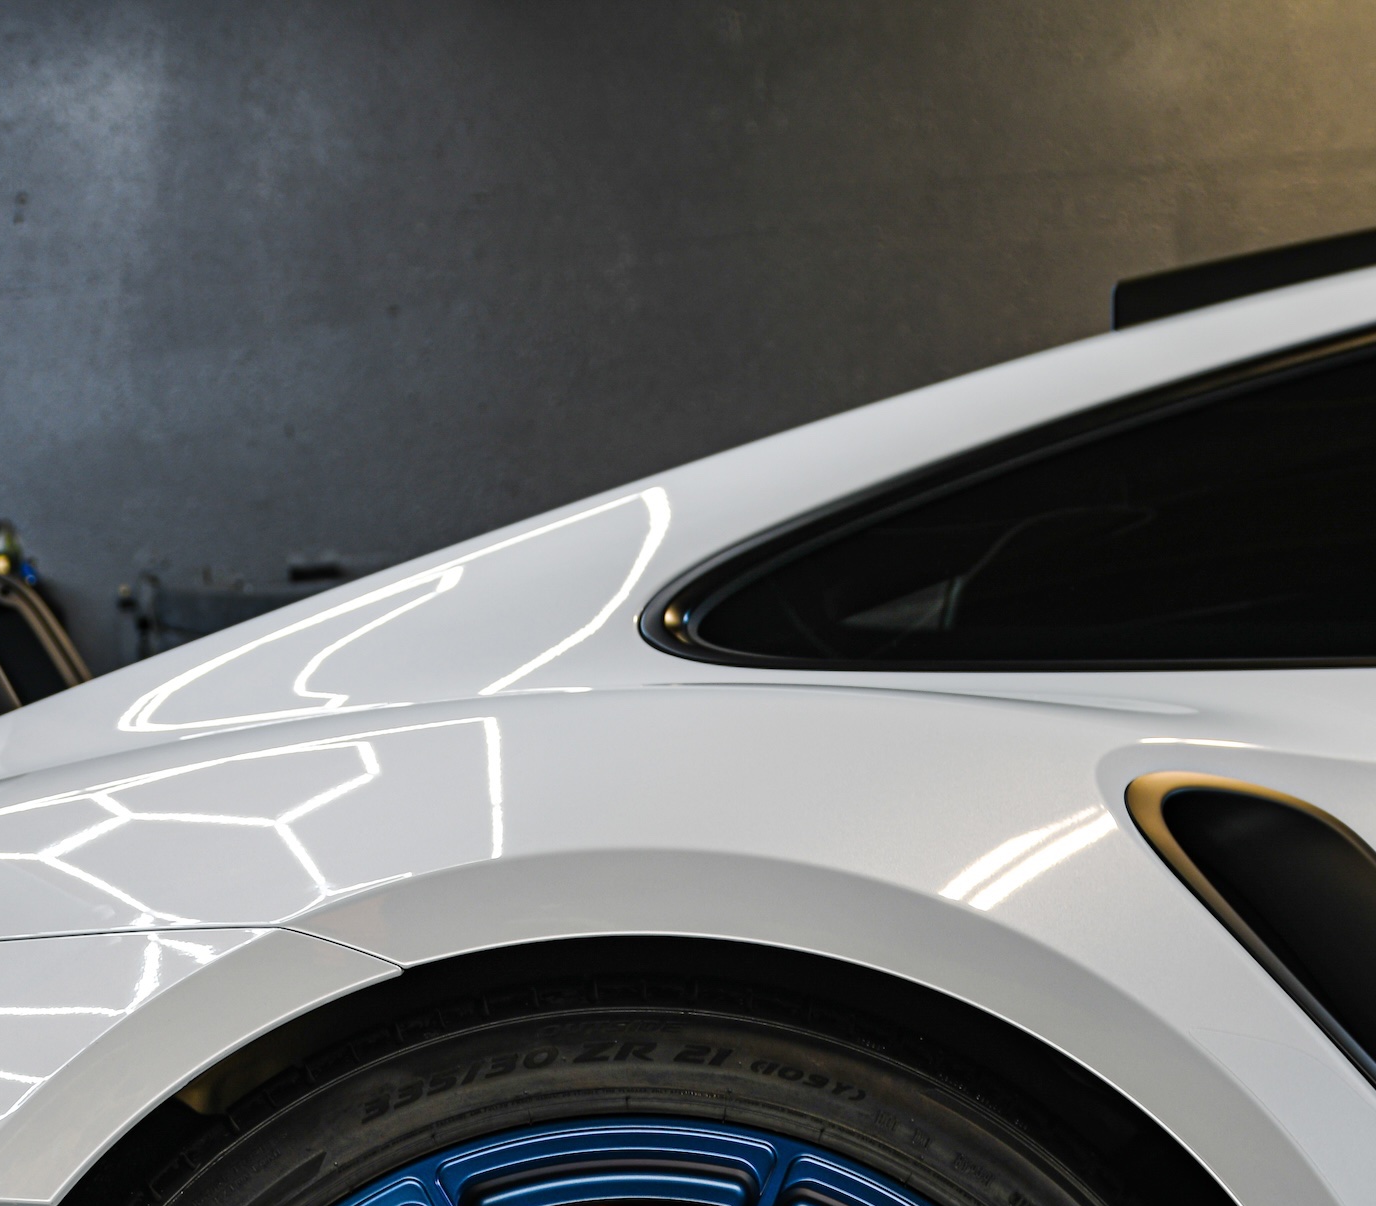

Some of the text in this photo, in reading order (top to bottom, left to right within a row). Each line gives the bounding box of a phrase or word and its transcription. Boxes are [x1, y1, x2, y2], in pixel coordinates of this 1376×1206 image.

[361, 1045, 557, 1125] 335/30
[570, 1038, 656, 1064] ZR
[679, 1041, 734, 1067] 21
